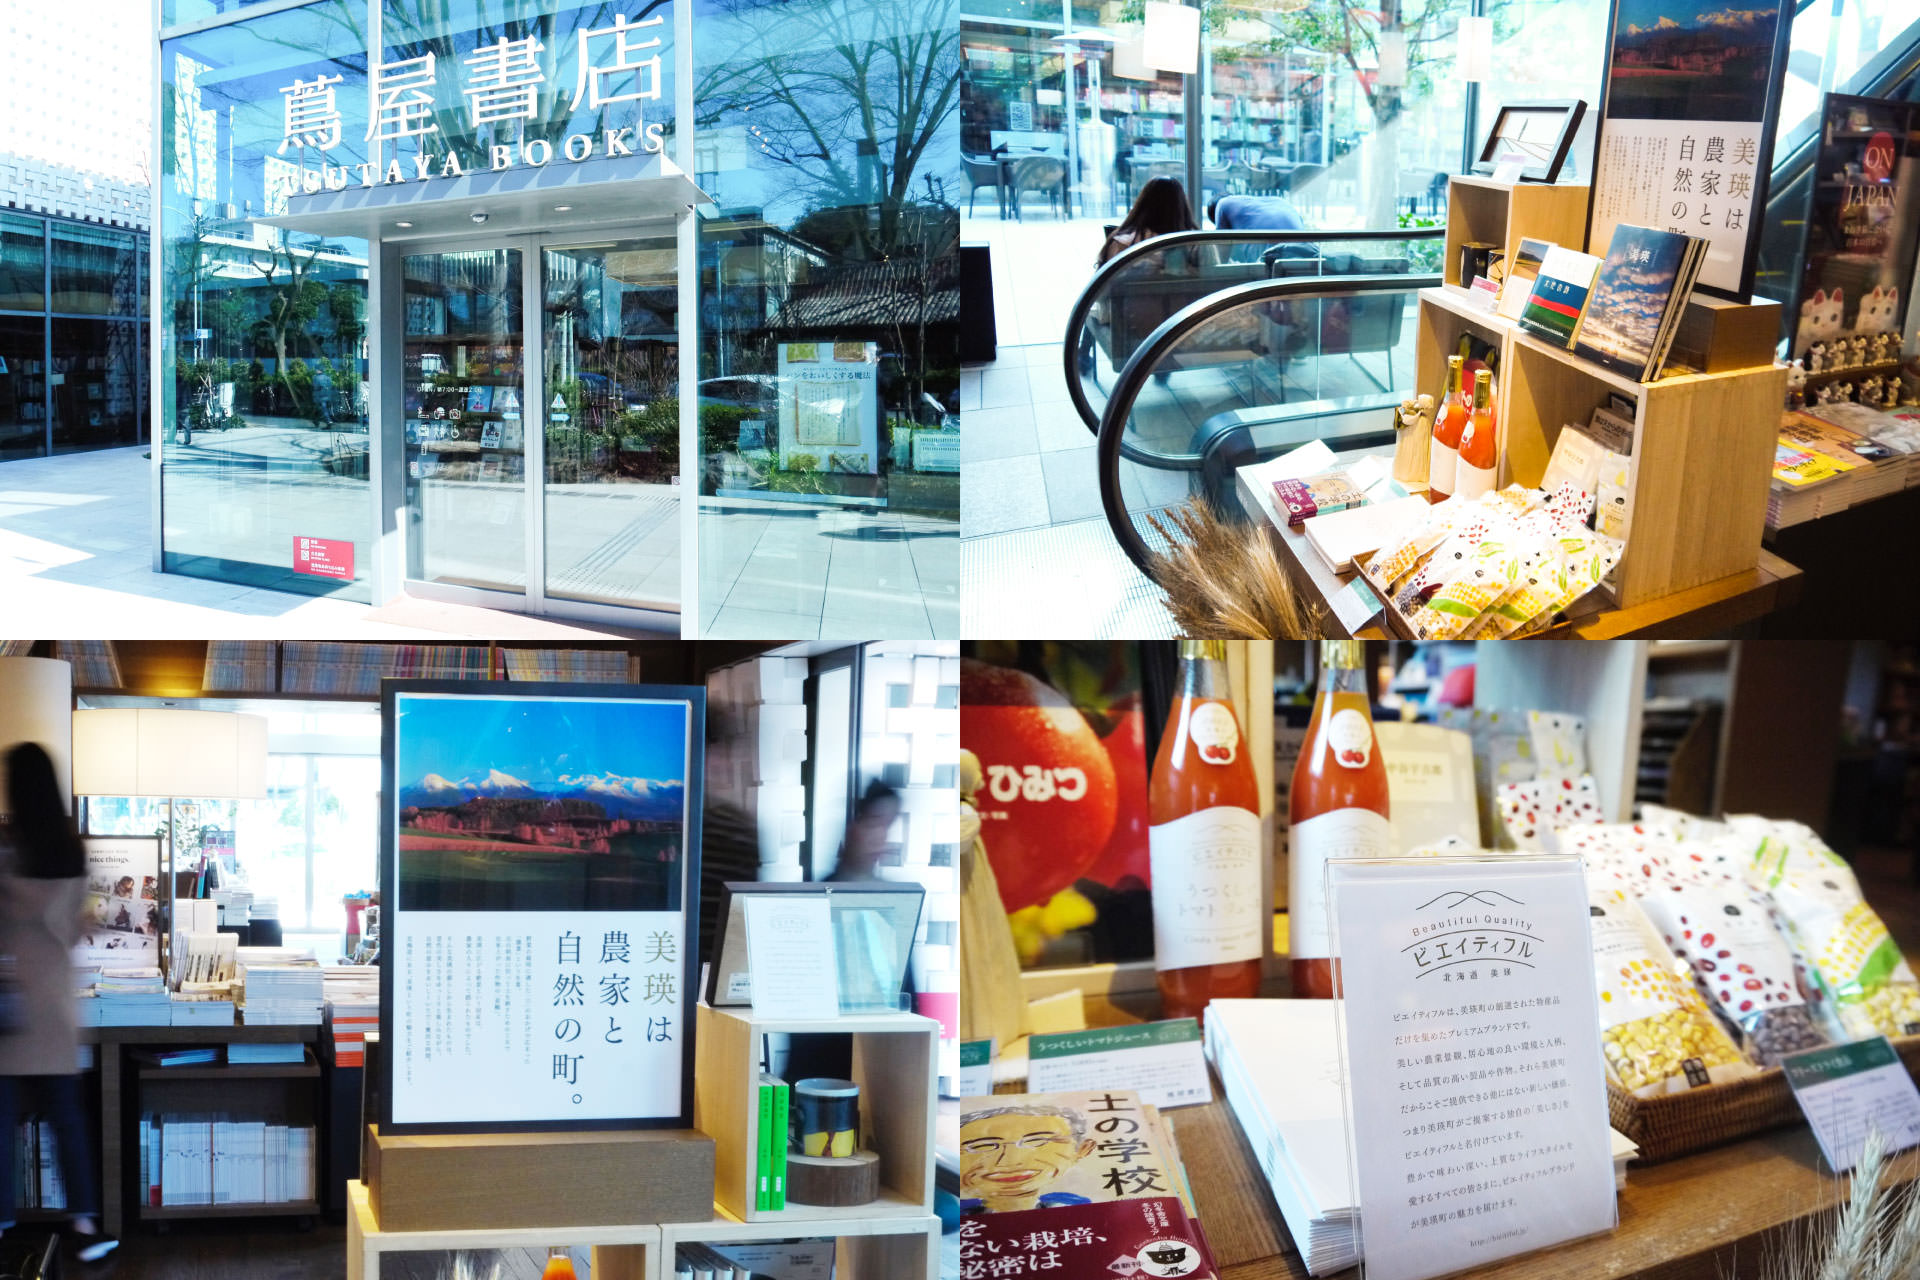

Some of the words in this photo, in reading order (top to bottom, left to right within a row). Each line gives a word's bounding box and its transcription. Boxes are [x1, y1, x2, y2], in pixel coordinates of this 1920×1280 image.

[277, 13, 664, 155] 蔦屋書店
[277, 150, 463, 198] TSUTAYA
[490, 122, 665, 173] BOOKS
[1699, 136, 1725, 226] 農家と
[1725, 138, 1757, 230] 美瑛は
[1865, 146, 1895, 169] ON
[1843, 184, 1899, 212] JAPAN
[987, 765, 1087, 802] ひみつ
[1412, 915, 1479, 937] Beautiful
[1484, 915, 1533, 930] Quality
[1413, 936, 1534, 968] ビエイティフル
[599, 930, 631, 1045] 農家と
[643, 930, 678, 1043] 美瑛は
[1443, 970, 1479, 982] 北海道
[552, 930, 585, 1105] 自然の町。
[1087, 1093, 1167, 1197] 土の学校
[960, 1226, 1108, 1258] ない栽培、
